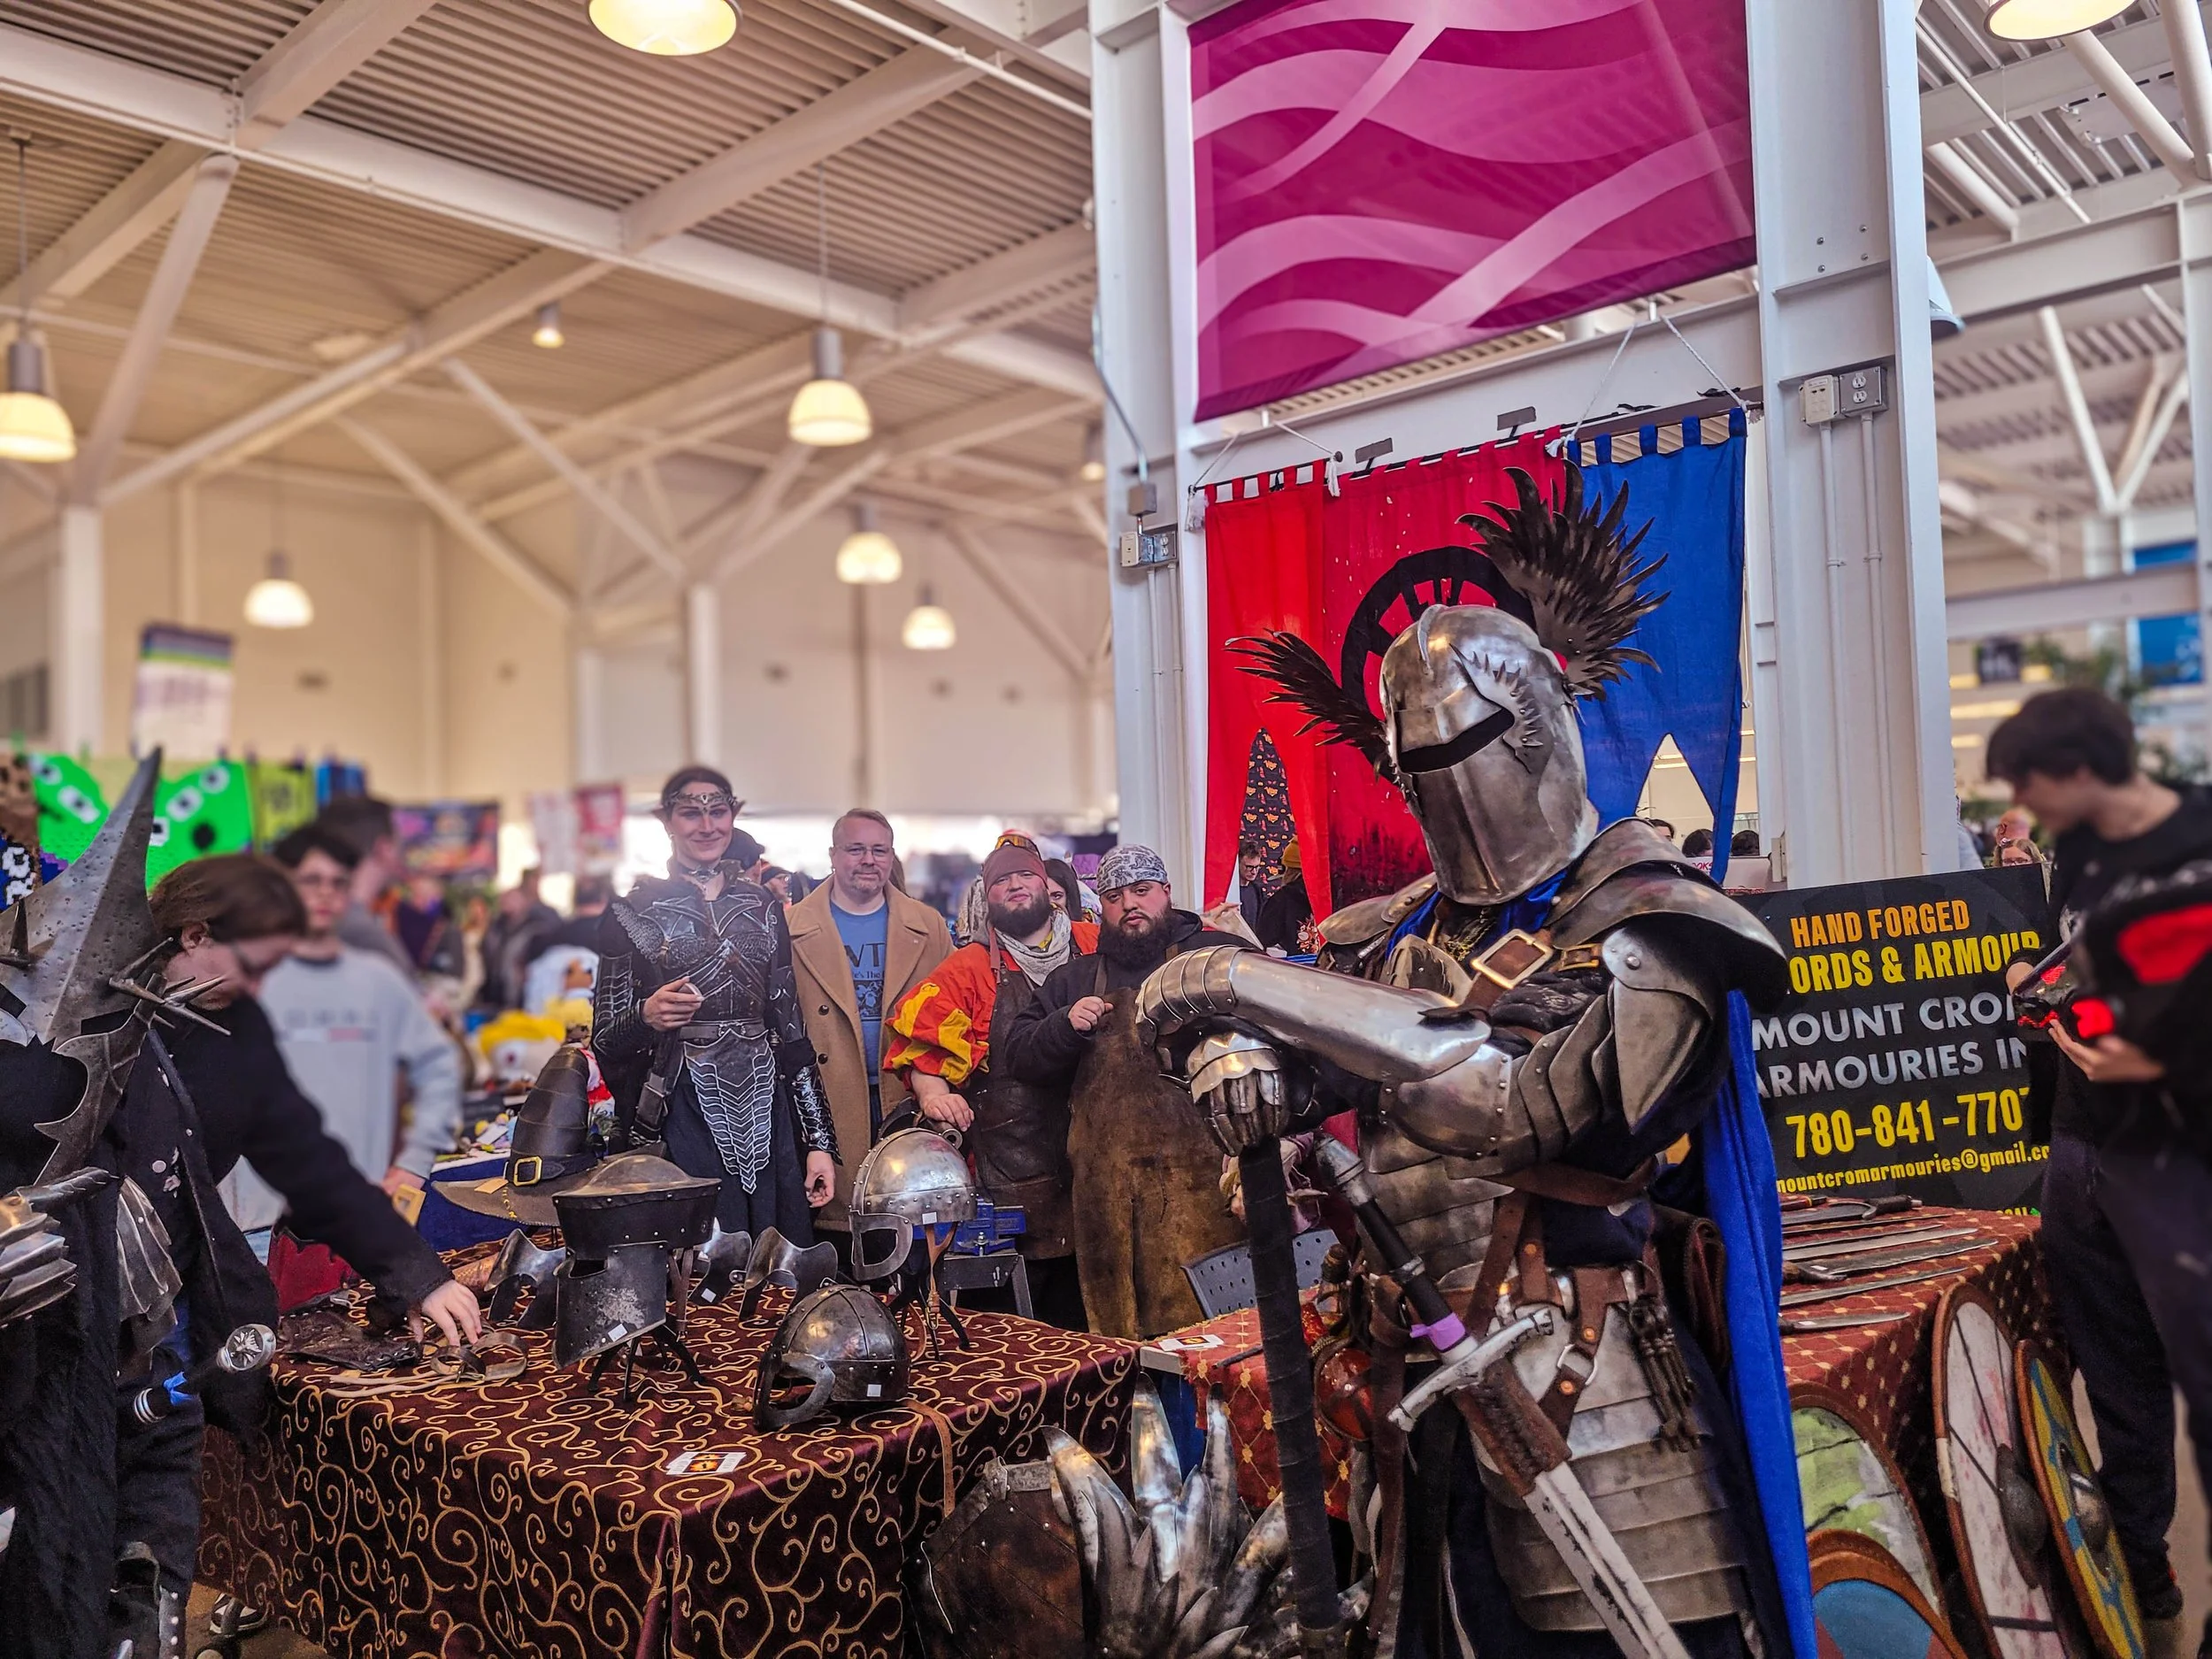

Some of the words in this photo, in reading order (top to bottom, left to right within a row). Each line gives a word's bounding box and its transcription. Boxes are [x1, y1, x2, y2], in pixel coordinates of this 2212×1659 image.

[1790, 911, 1863, 948] HAND
[1867, 899, 1970, 940] FORGED
[1881, 946, 1906, 984] &
[1752, 1002, 1904, 1051] MOUNT
[1919, 992, 2016, 1031] CRO
[1786, 1087, 2030, 1158] 780-841-770
